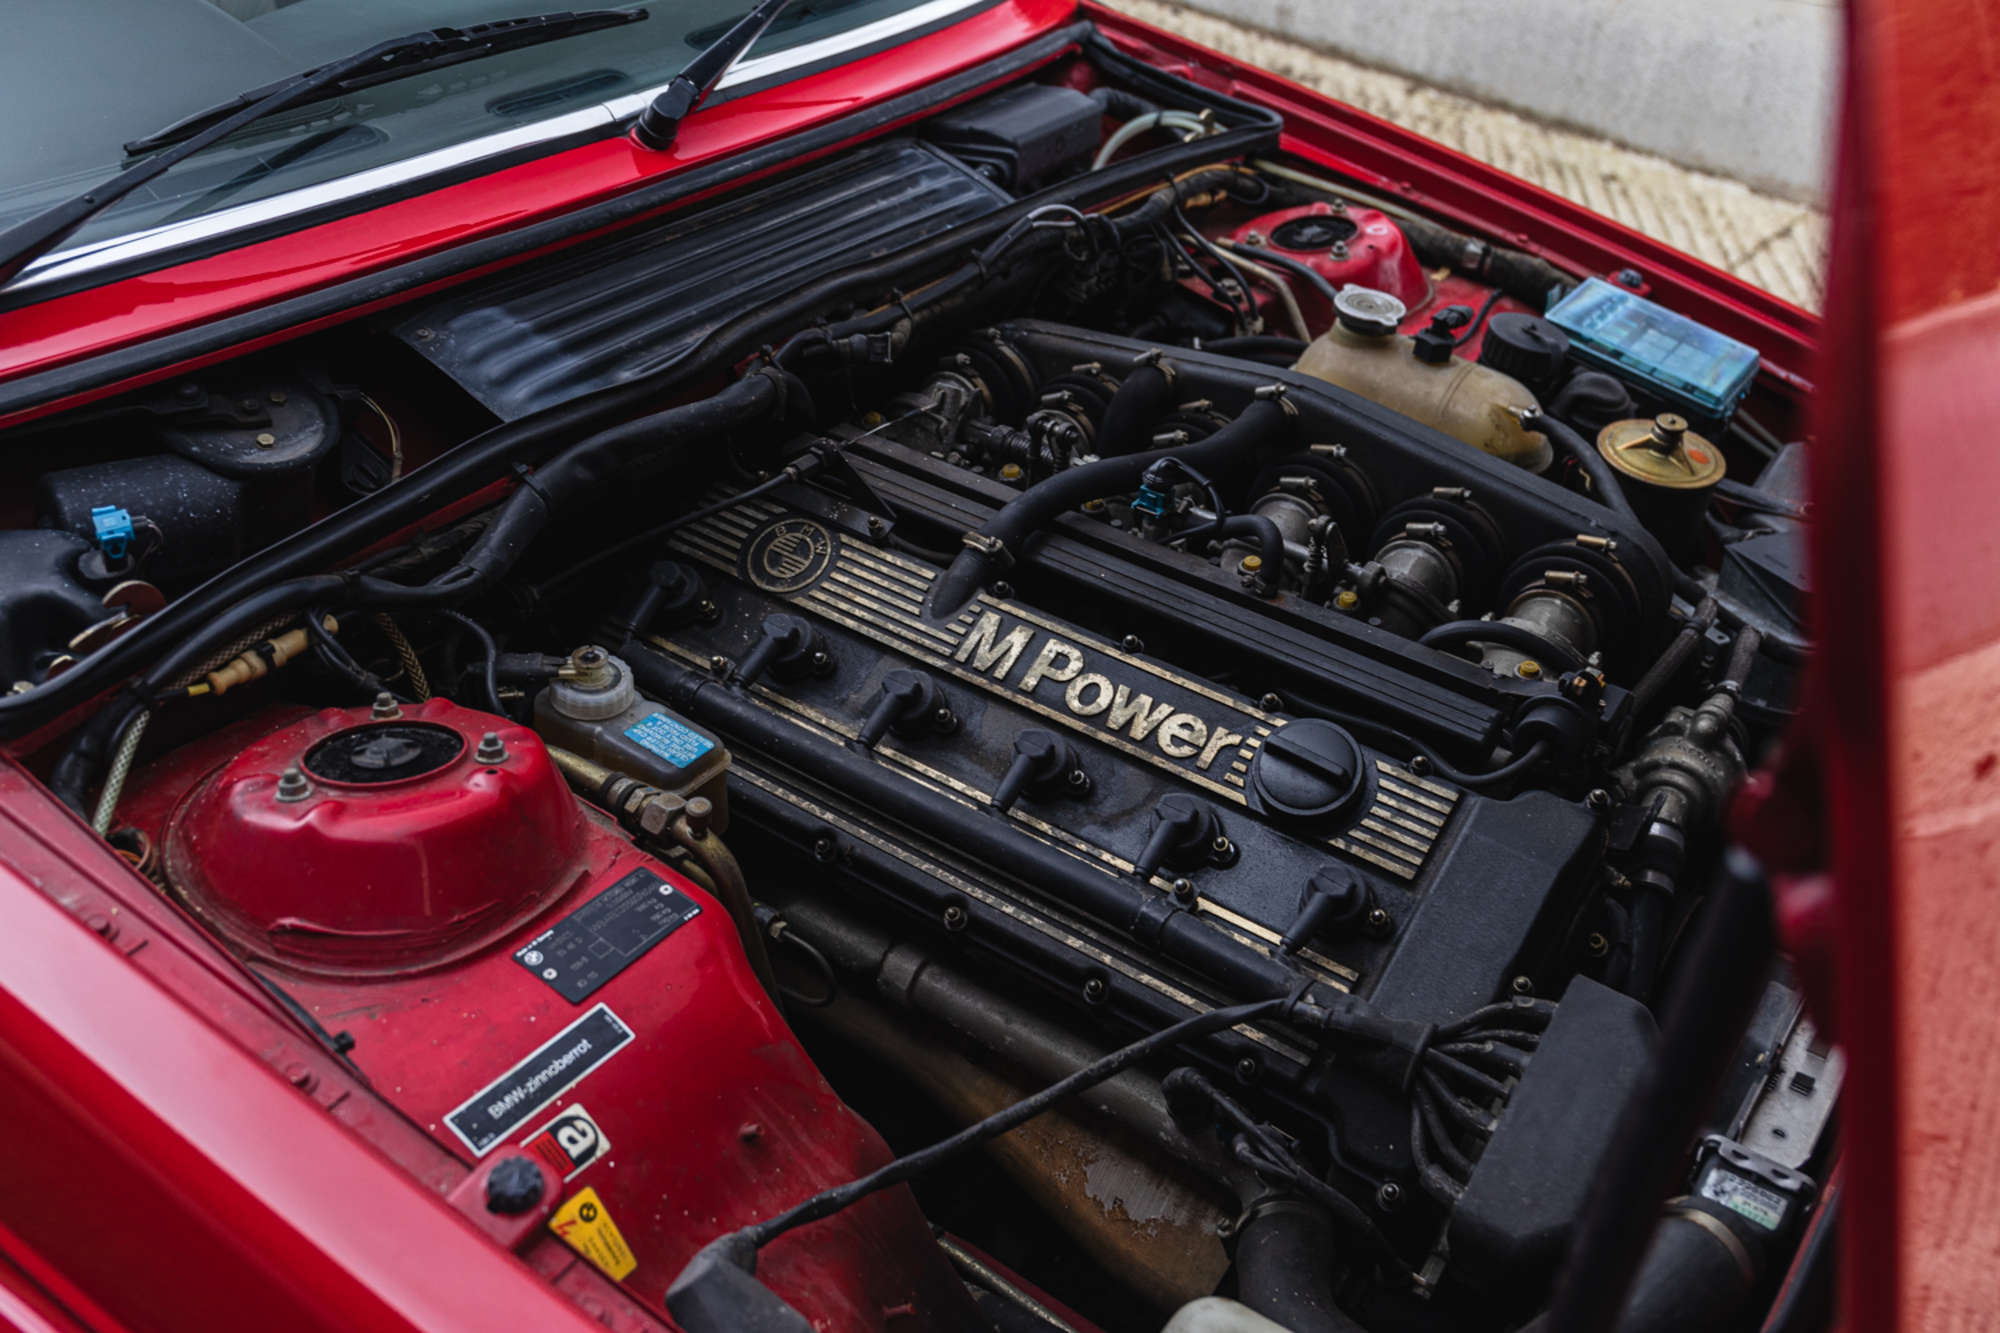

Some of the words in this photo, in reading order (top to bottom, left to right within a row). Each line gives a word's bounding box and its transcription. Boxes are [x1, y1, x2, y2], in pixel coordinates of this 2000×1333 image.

[775, 524, 828, 556] BMW
[954, 609, 1035, 680] M
[1018, 637, 1243, 770] Power
[487, 1037, 593, 1121] BMW-zinnoberrot
